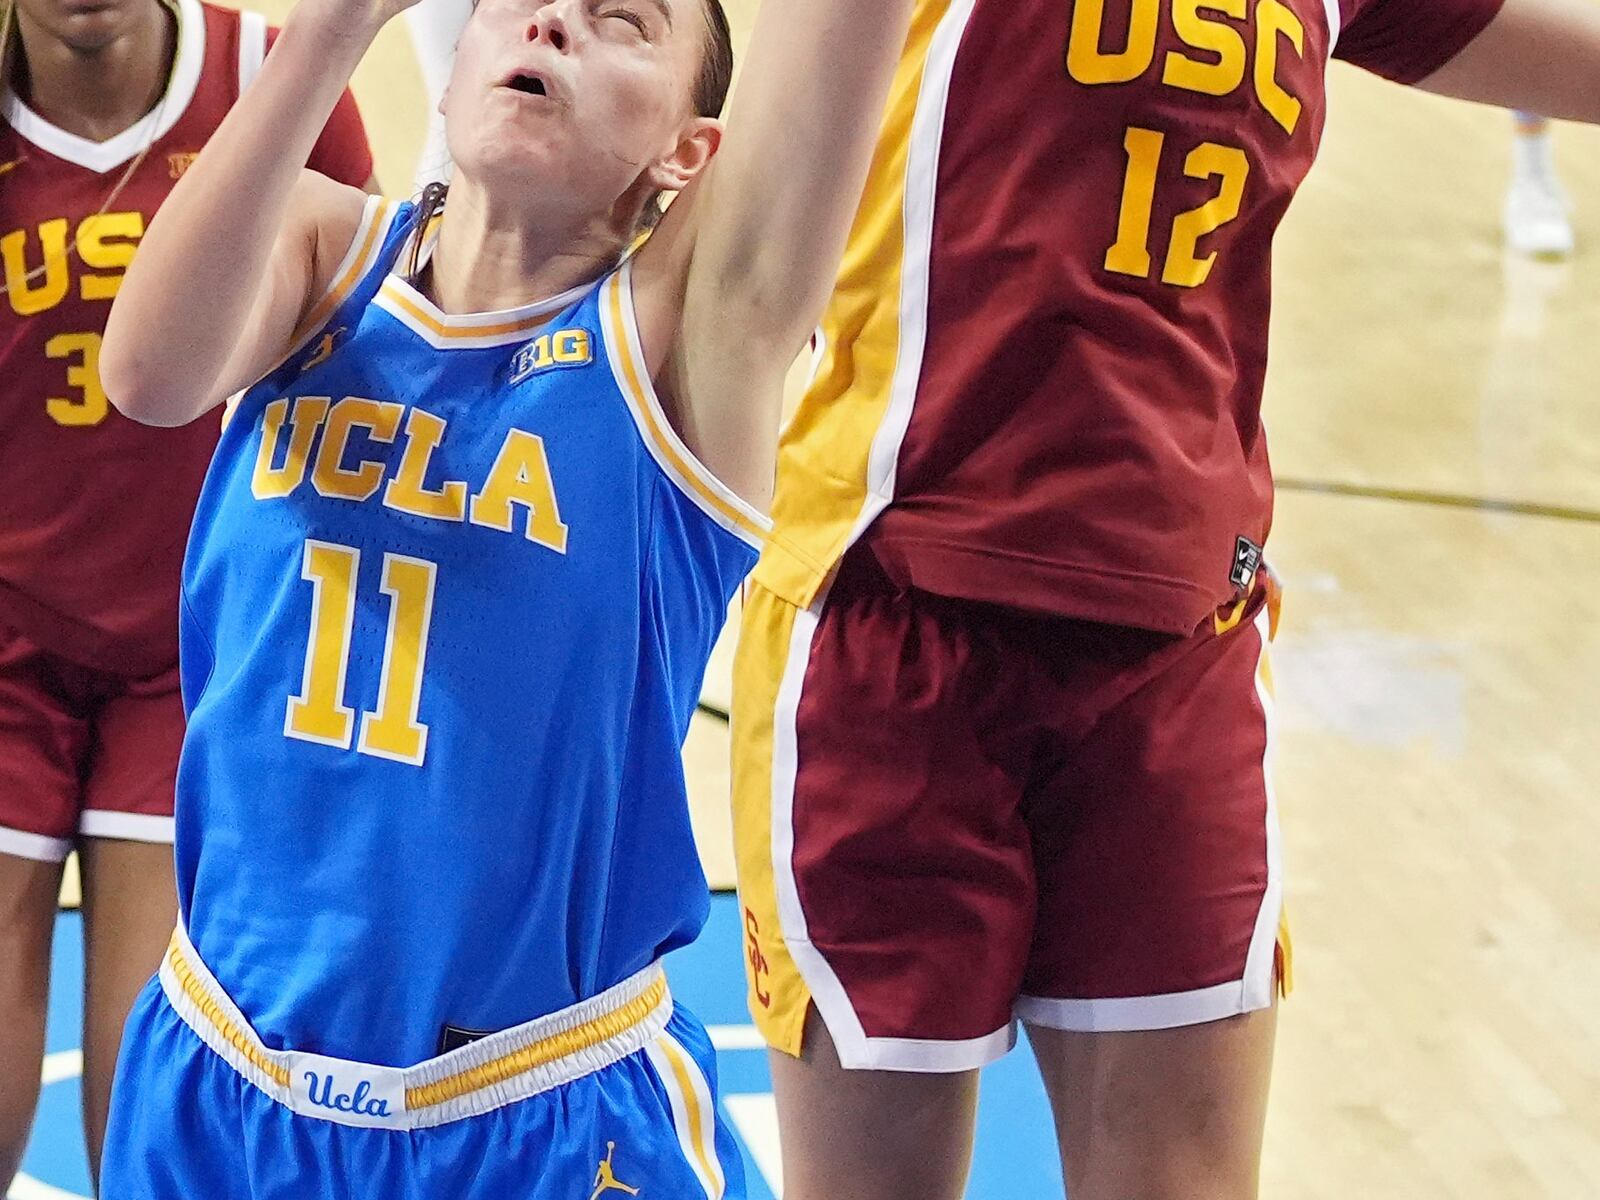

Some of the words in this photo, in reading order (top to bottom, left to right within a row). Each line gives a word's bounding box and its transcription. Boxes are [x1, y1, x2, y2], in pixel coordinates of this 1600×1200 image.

[0, 211, 145, 316] US
[1104, 126, 1249, 288] 12
[45, 332, 109, 427] 3
[250, 396, 568, 555] UCLA
[283, 538, 438, 767] 11
[303, 1071, 392, 1117] Ucla
